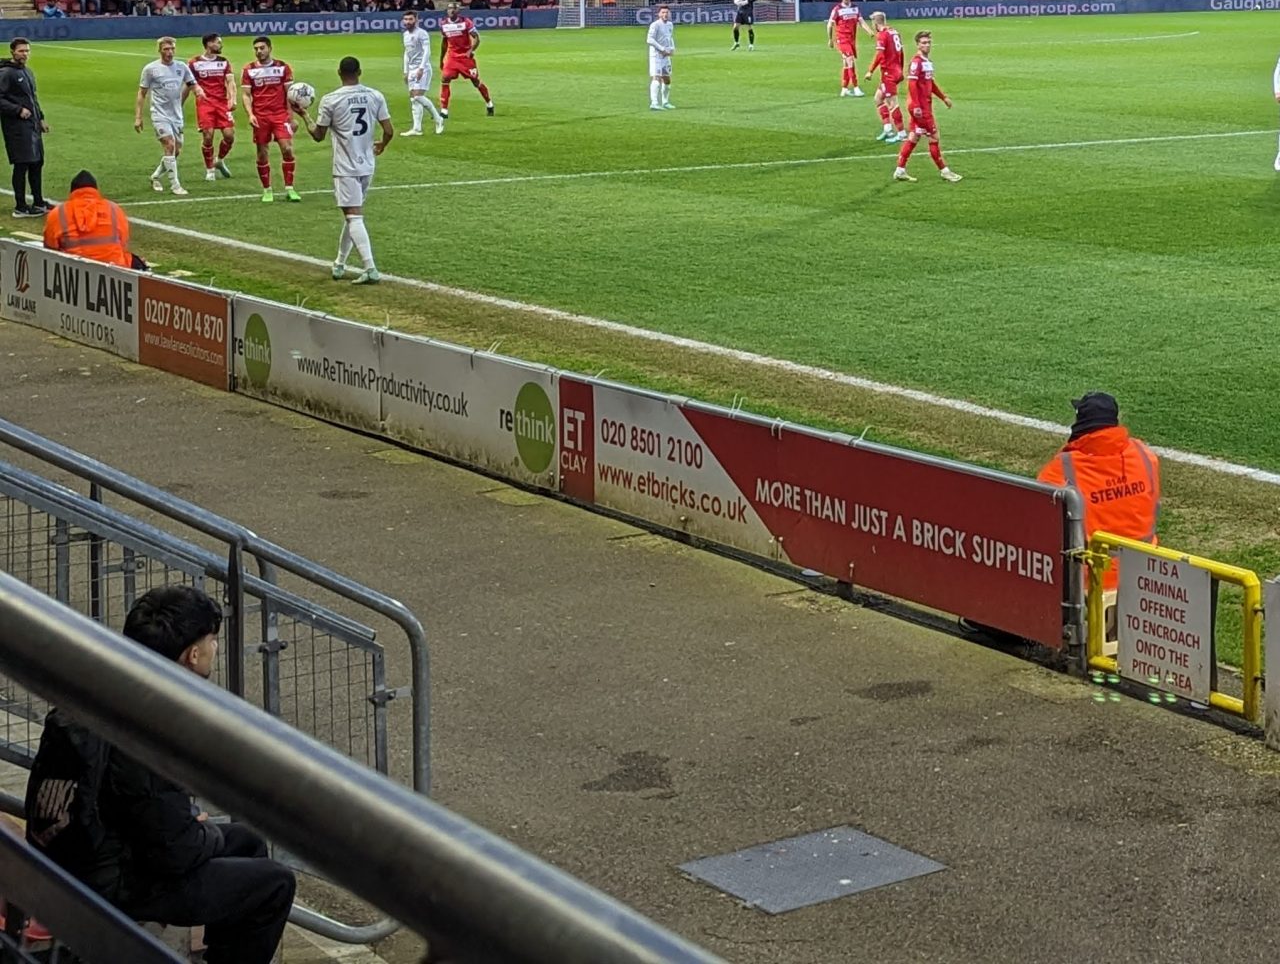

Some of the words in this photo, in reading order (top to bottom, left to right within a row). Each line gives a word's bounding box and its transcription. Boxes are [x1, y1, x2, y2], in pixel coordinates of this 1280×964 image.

[905, 0, 1116, 18] www.gaughangroup.com
[351, 108, 368, 136] 3
[7, 293, 20, 310] LAW
[21, 296, 36, 314] LANE
[43, 259, 79, 307] LAW
[85, 271, 133, 324] LANE
[60, 313, 115, 345] SOLICITORS
[144, 298, 171, 326] 0207
[173, 305, 193, 333] 870
[194, 311, 201, 336] 4
[203, 314, 224, 343] 870
[297, 356, 468, 417] www.ReThinkProductivity.co.uk
[563, 408, 586, 452] ET
[601, 418, 626, 447] 020
[630, 426, 661, 458] 8501
[667, 437, 703, 469] 2100
[561, 452, 587, 475] CLAY
[598, 462, 747, 524] www.etbricks.co.uk
[1090, 480, 1146, 504] STEWARD
[755, 478, 801, 511] MORE
[804, 489, 846, 525] THAN
[851, 503, 888, 536] JUST
[893, 515, 907, 543] A
[912, 519, 967, 559] BRICK
[972, 535, 1054, 585] SUPPLIER
[1147, 557, 1157, 572] IT
[1160, 561, 1168, 577] IS
[1171, 564, 1179, 579] A
[1137, 576, 1189, 604] CRIMINAL
[1140, 598, 1186, 624] OFFENCE
[1126, 614, 1139, 630] TO
[1143, 620, 1200, 650] ENCROACH
[1136, 639, 1166, 661] ONTO
[1168, 649, 1190, 669] THE
